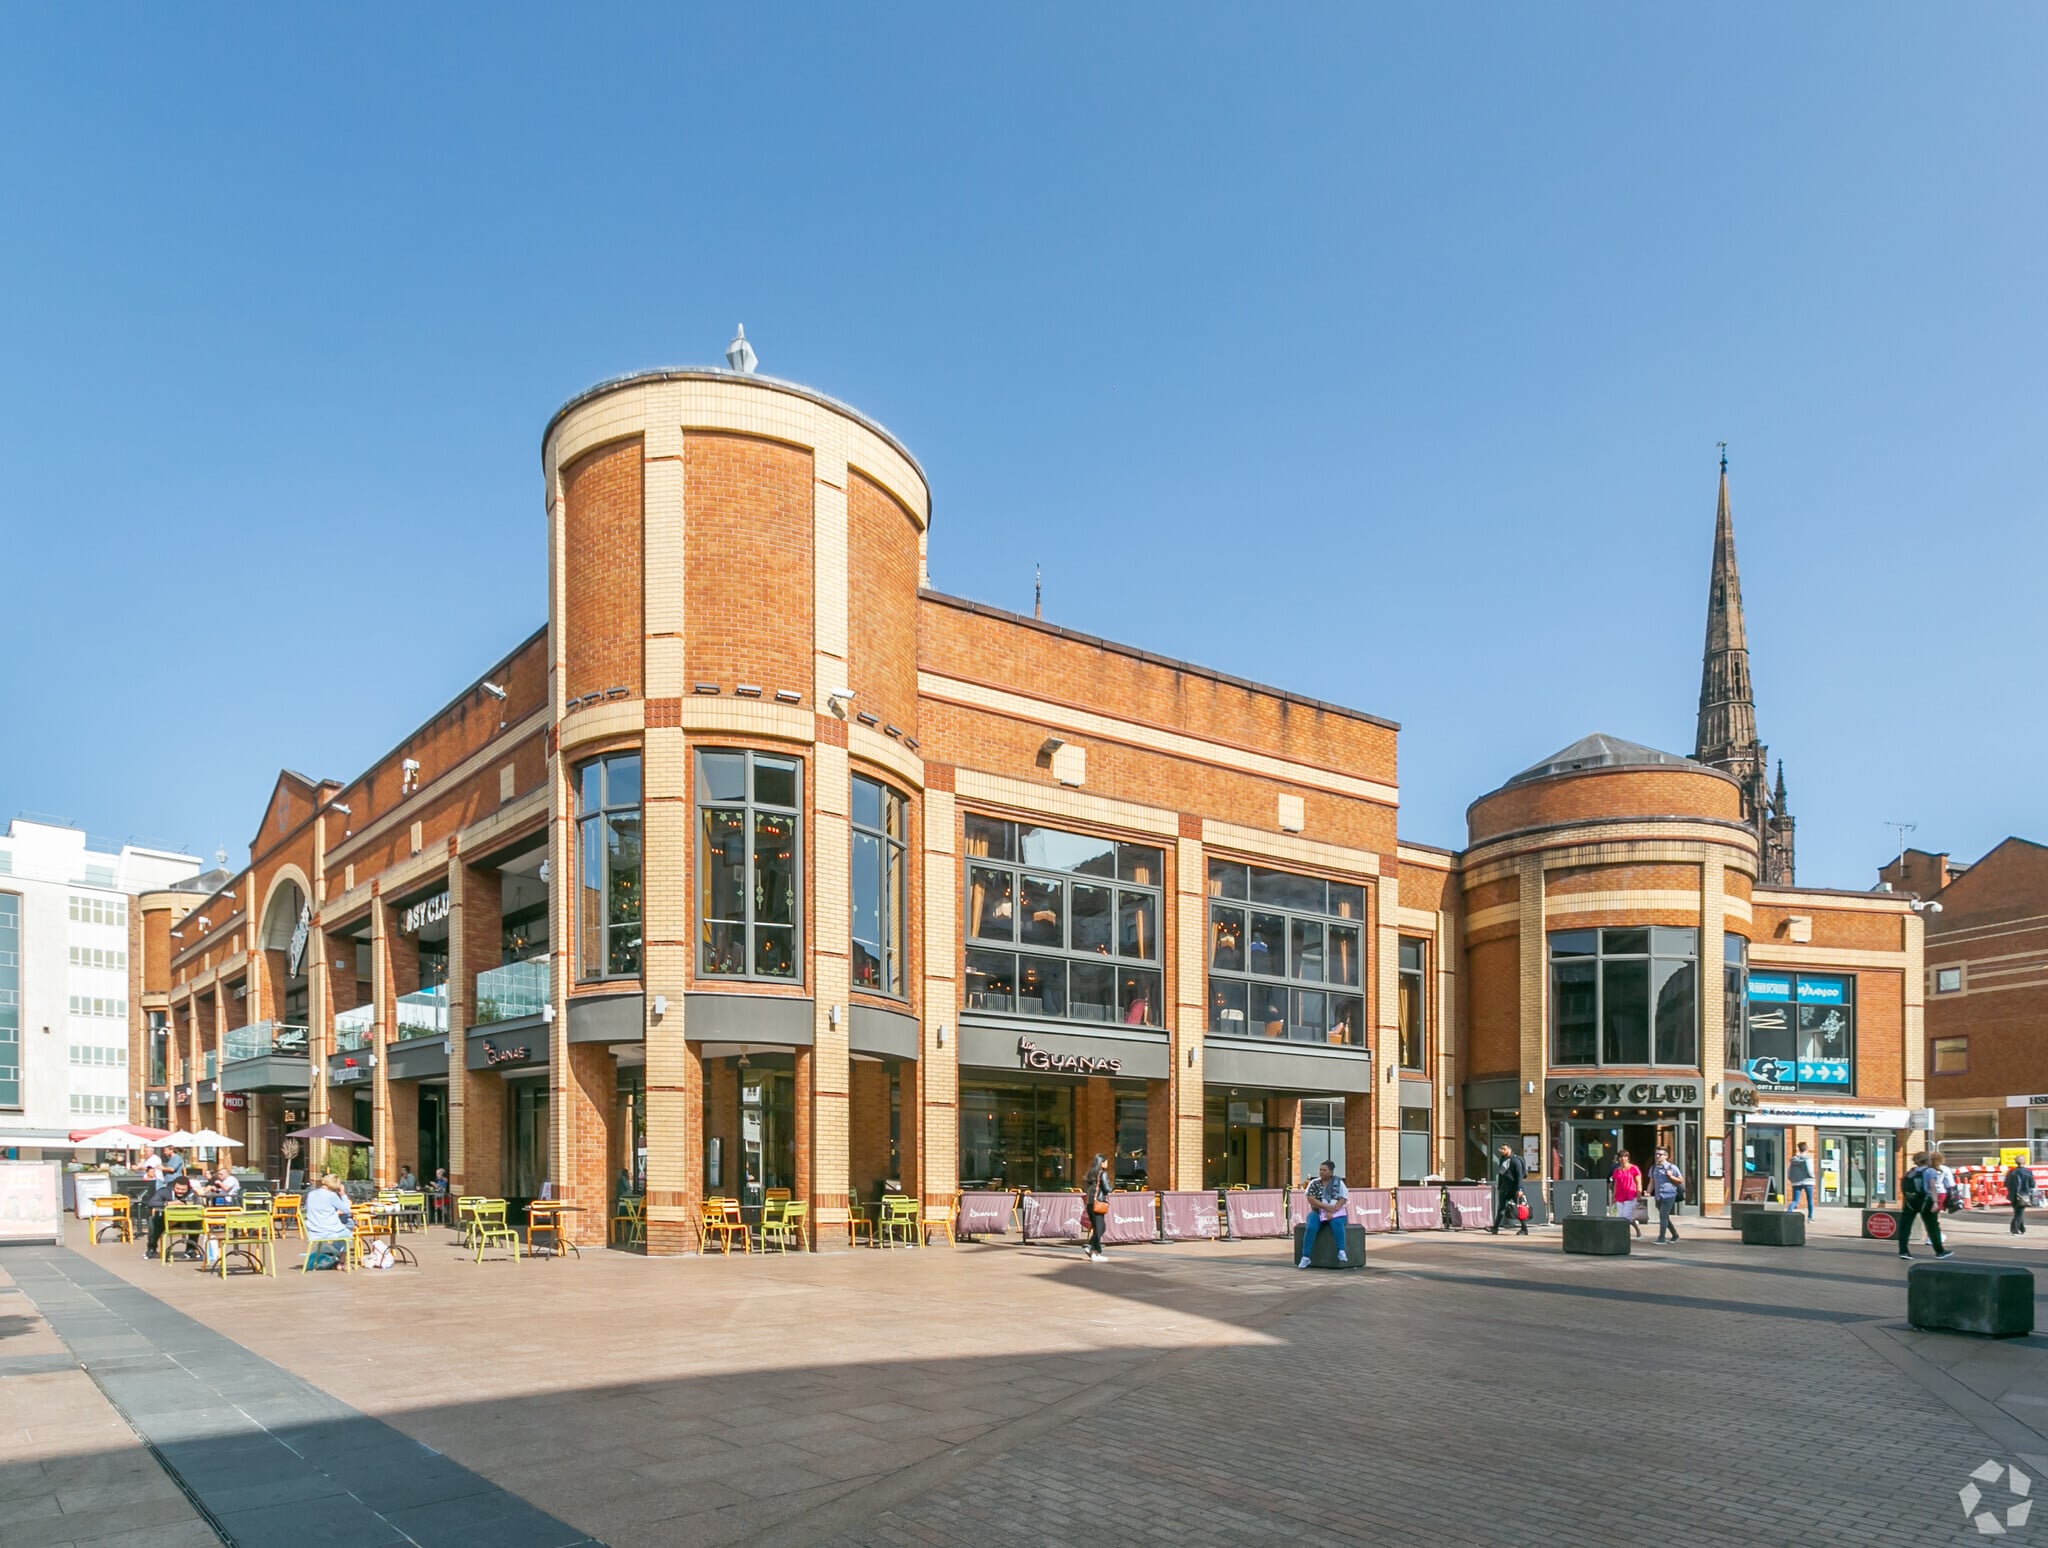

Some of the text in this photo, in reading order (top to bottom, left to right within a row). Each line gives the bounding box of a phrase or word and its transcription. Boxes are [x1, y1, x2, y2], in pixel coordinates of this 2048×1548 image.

[427, 891, 449, 923] CLU
[1024, 1050, 1122, 1071] IGUANAS
[1632, 1084, 1698, 1103] CLUB
[2029, 1096, 2048, 1105] HS
